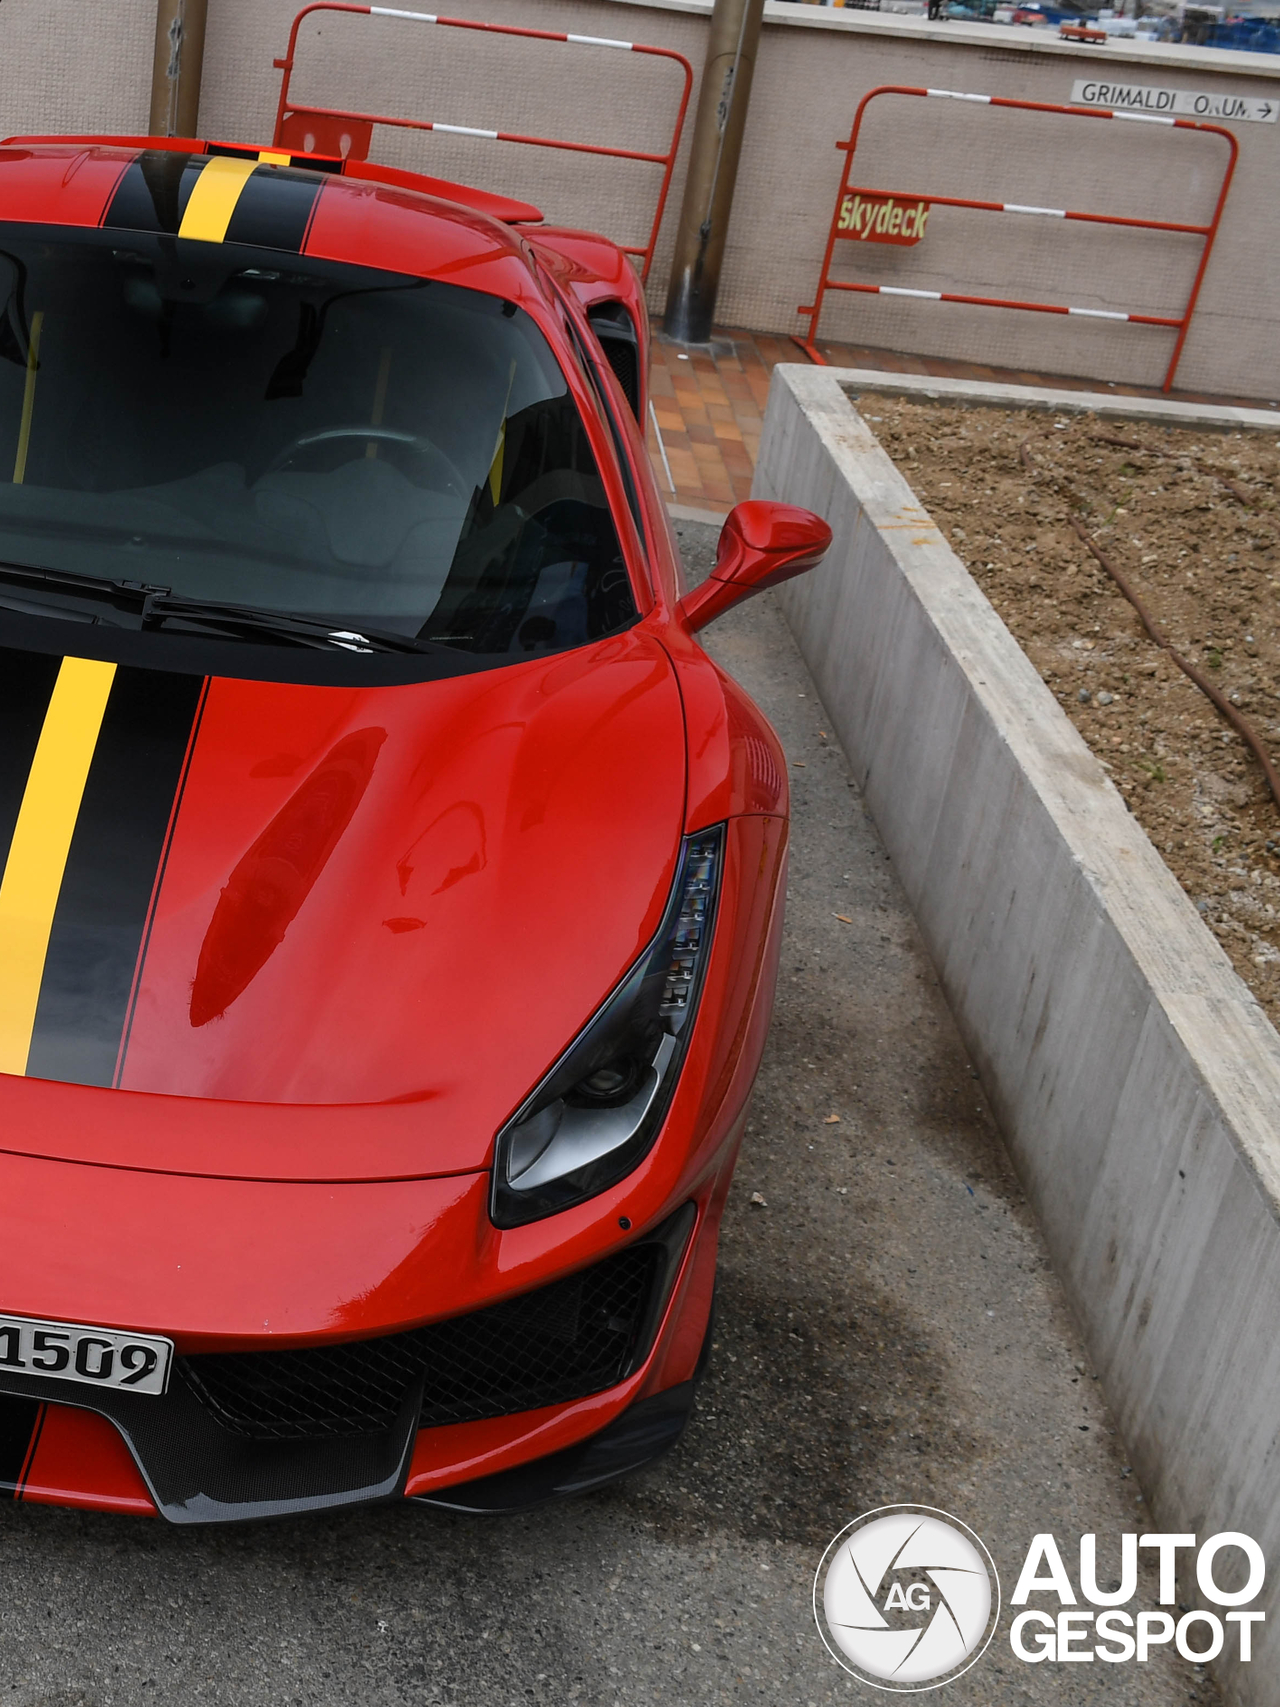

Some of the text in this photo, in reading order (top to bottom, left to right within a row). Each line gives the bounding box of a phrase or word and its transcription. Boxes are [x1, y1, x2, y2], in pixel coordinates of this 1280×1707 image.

[1082, 83, 1251, 119] GRIMALDI OUM
[837, 195, 929, 239] skydeck
